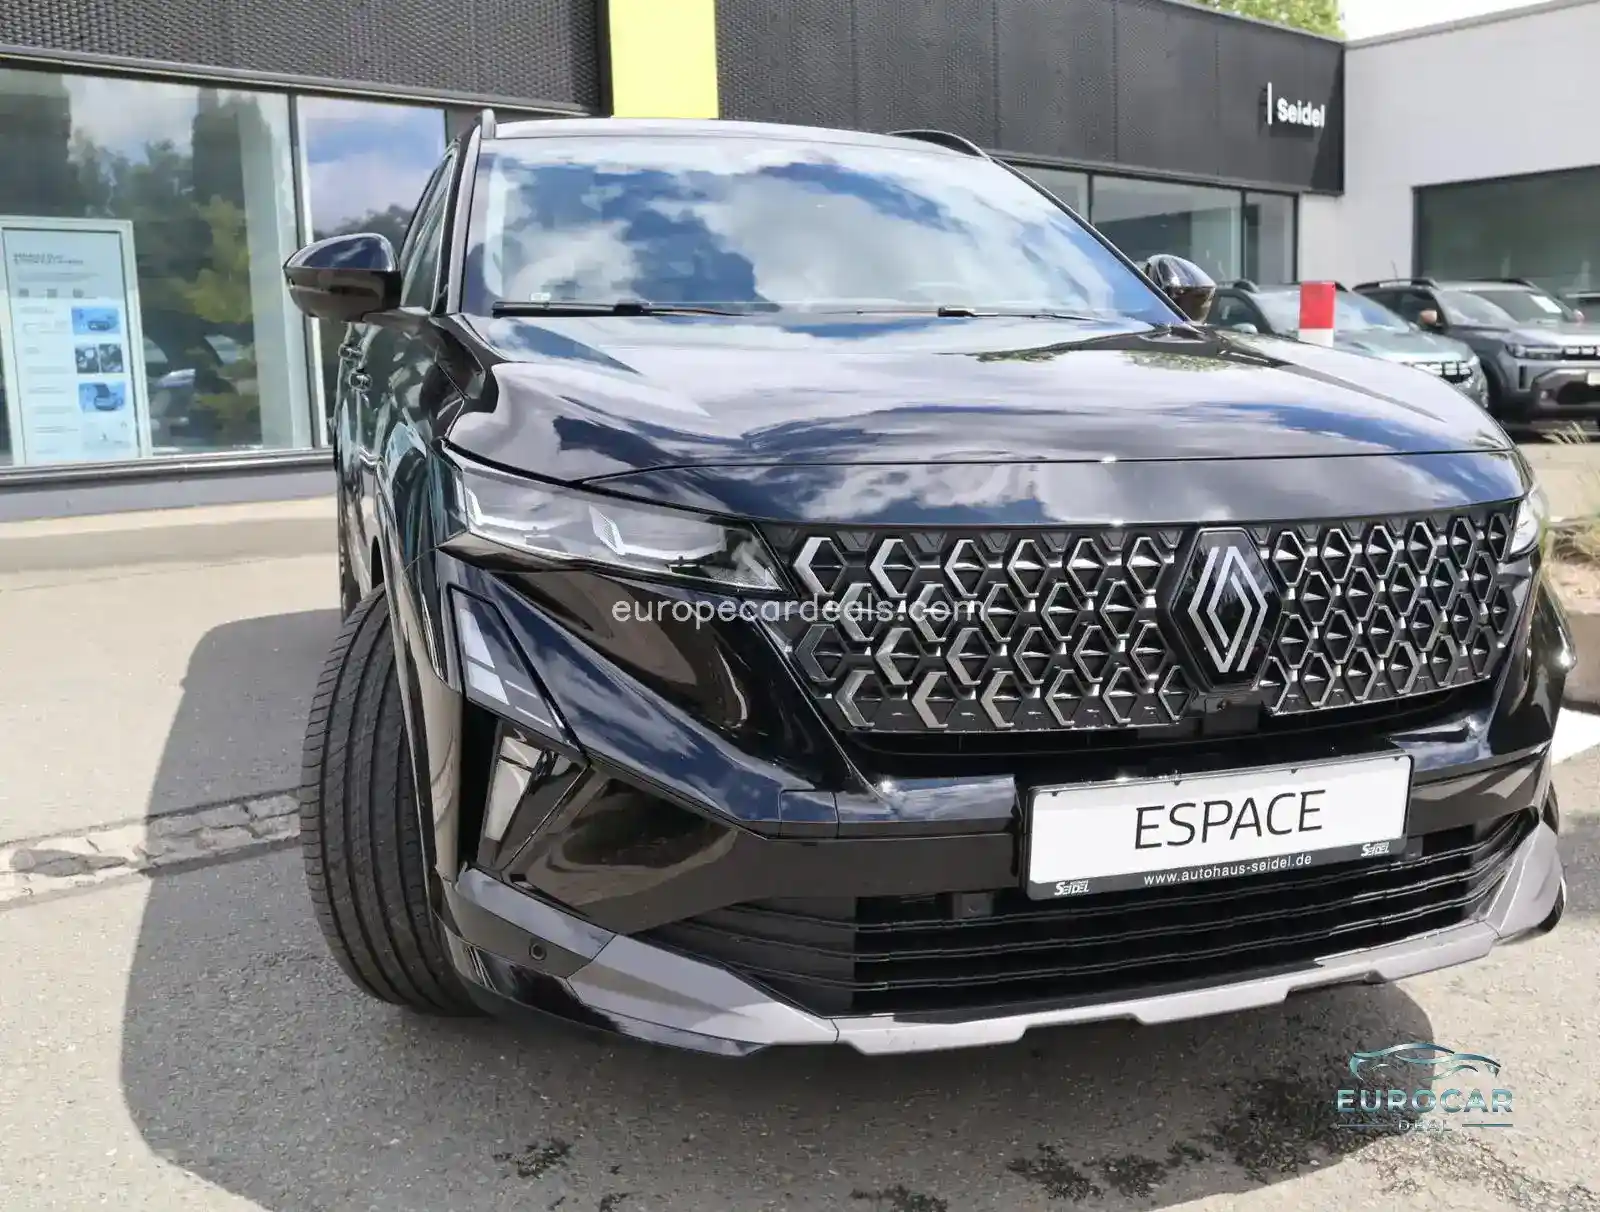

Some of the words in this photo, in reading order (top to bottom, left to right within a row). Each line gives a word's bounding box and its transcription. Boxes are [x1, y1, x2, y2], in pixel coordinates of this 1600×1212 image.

[1277, 97, 1326, 128] Seidel
[1134, 789, 1326, 850] ESPACE
[1143, 853, 1312, 886] www.autohaus-seidel.de
